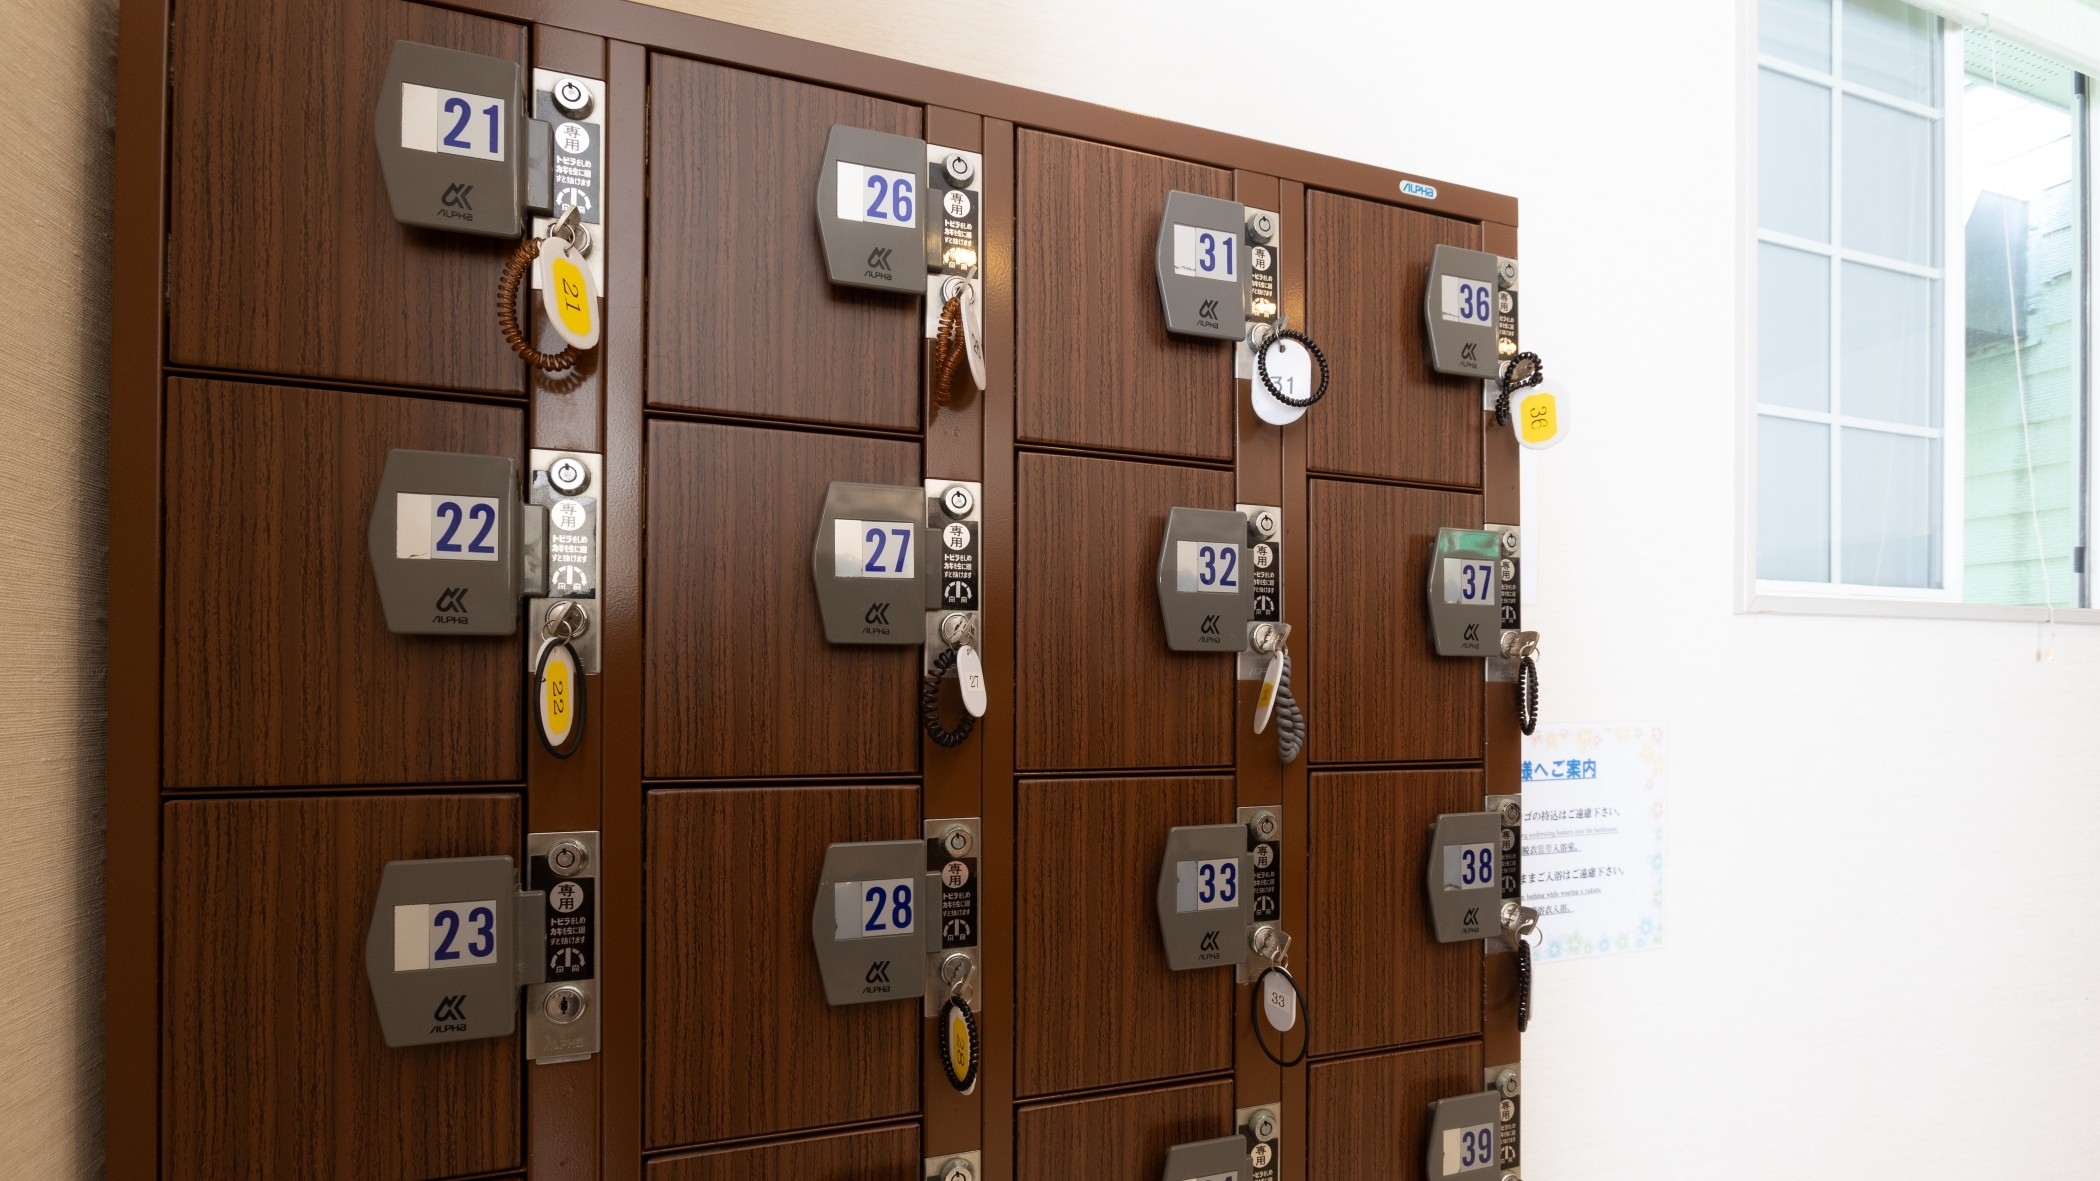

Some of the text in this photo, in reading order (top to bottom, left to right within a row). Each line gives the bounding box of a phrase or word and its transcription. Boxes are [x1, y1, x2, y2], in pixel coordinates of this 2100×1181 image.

[443, 97, 499, 153] 21
[564, 125, 581, 151] 専用
[867, 175, 912, 222] 26
[950, 193, 963, 215] 専用
[1200, 233, 1233, 275] 31
[1255, 249, 1265, 268] 専用
[562, 277, 581, 311] 21
[1460, 284, 1489, 321] 36
[1530, 406, 1548, 430] 36
[436, 502, 495, 553] 22
[560, 503, 577, 528] 専用
[865, 528, 911, 573] 27
[950, 525, 963, 548] 専用
[1200, 546, 1237, 587] 32
[1257, 546, 1267, 566] 専用
[1463, 565, 1492, 600] 37
[553, 681, 564, 715] 22
[970, 675, 979, 688] 27
[1258, 846, 1268, 866] 専用
[1463, 848, 1492, 884] 38
[949, 863, 962, 886] 専用
[1199, 864, 1237, 903] 33
[558, 884, 575, 910] 専用
[865, 885, 912, 931] 28
[434, 907, 494, 960] 23
[1271, 991, 1285, 1008] 33
[956, 1034, 965, 1066] 28
[1256, 1146, 1266, 1166] 専用
[1462, 1128, 1491, 1166] 39
